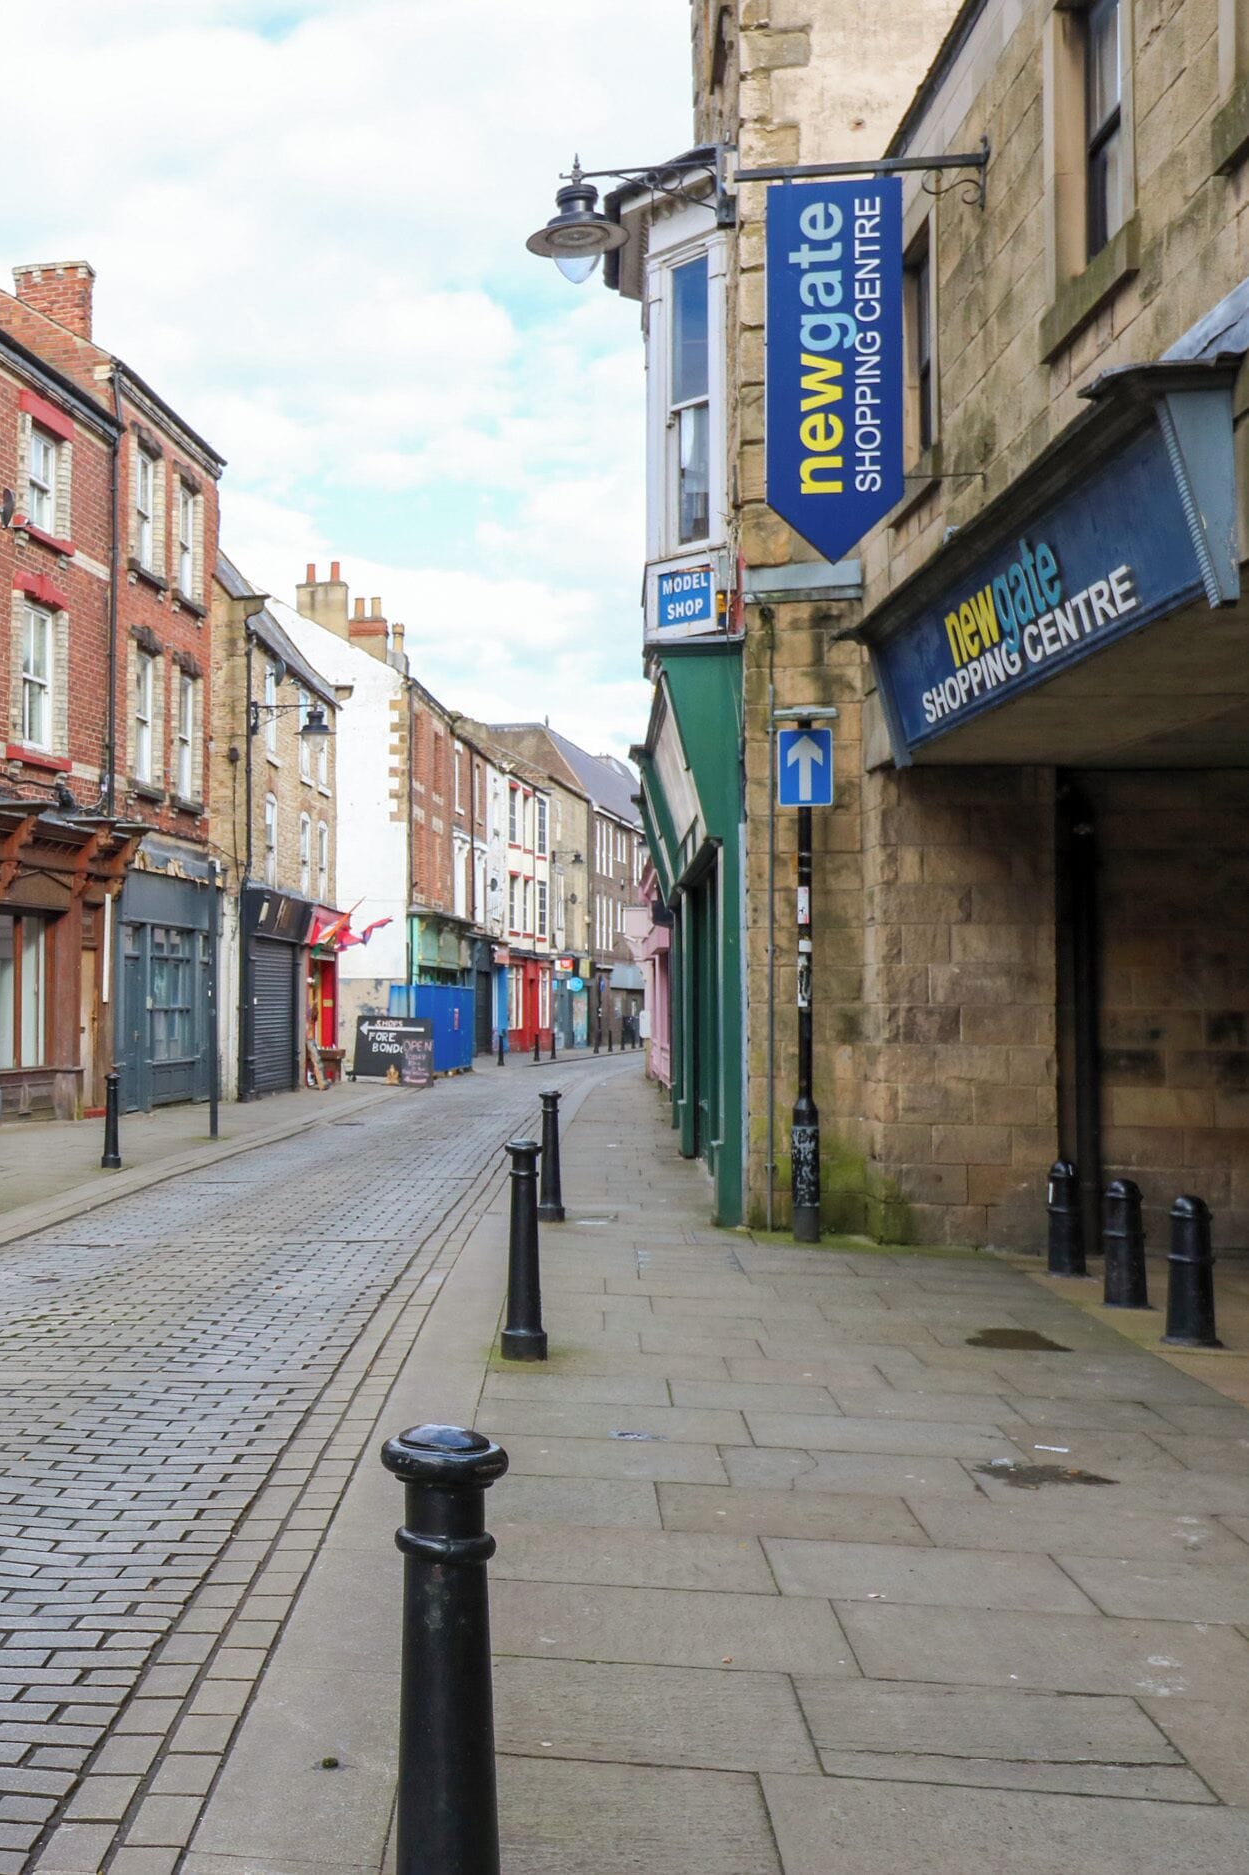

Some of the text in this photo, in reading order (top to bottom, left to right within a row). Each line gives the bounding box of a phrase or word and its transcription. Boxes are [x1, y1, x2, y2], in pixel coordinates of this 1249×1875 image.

[789, 202, 857, 494] newgate
[854, 196, 882, 492] SHOPPING CENTRE
[662, 572, 708, 595] MODEL
[667, 598, 703, 620] SHOP
[944, 538, 1062, 669] newgate
[922, 564, 1138, 723] SHOPPING CENTRE
[368, 1032, 397, 1042] FORE
[372, 1042, 403, 1053] BOND
[403, 1040, 432, 1052] OPEN
